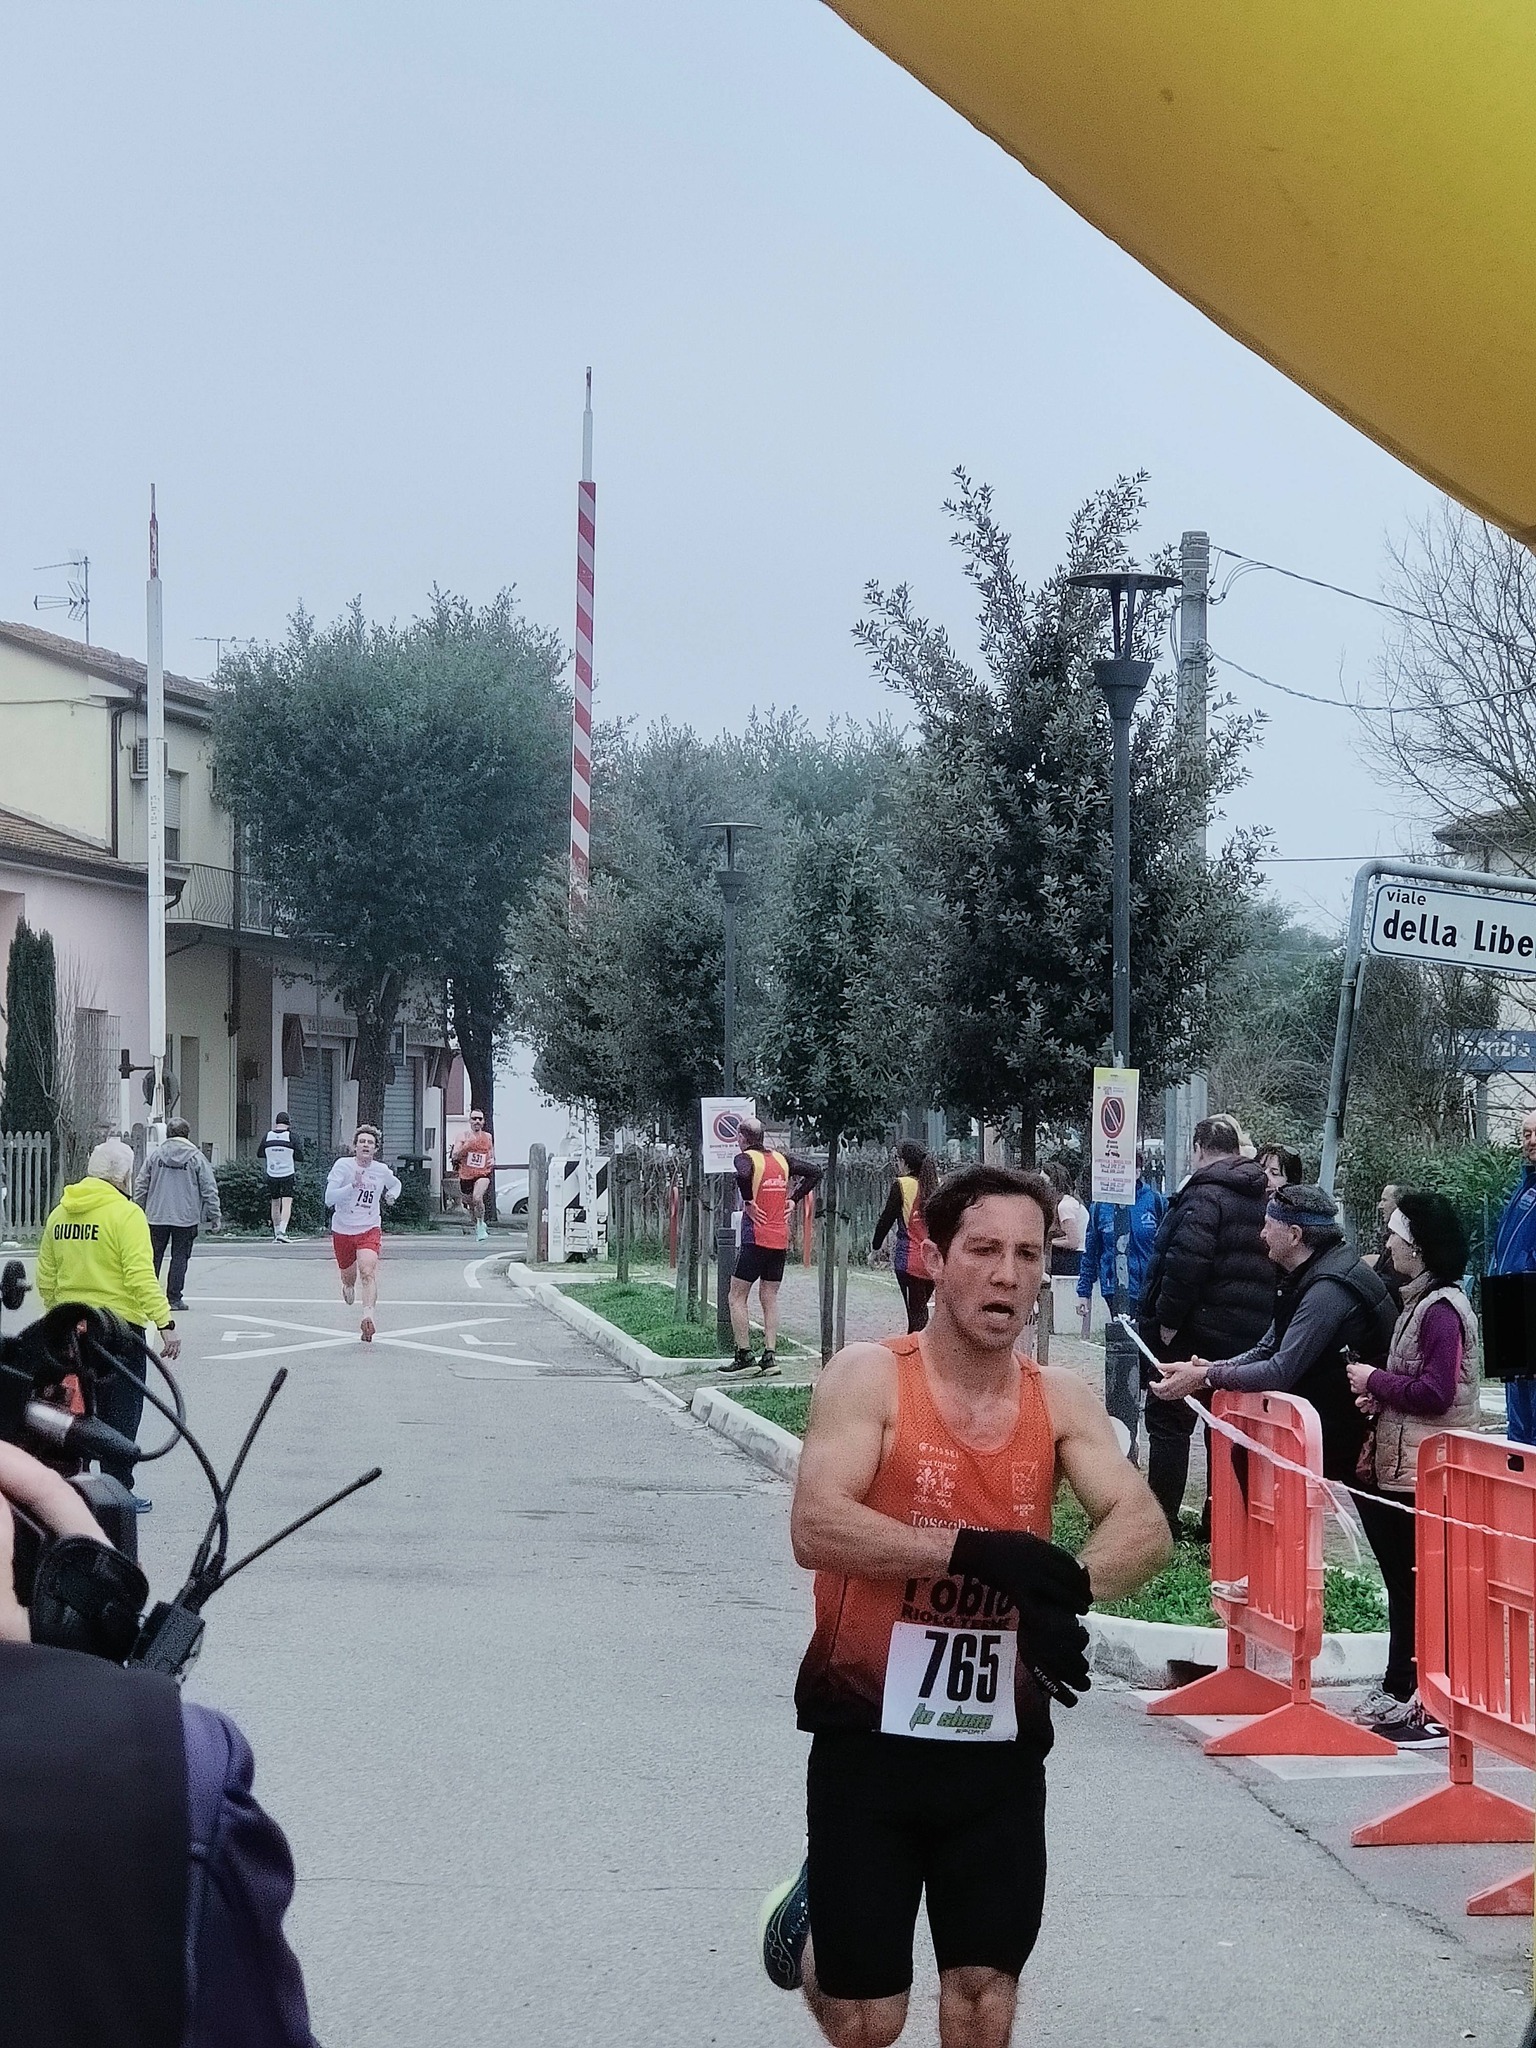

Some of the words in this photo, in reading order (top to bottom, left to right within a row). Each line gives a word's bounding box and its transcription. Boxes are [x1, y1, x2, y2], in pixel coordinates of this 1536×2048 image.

[1386, 889, 1427, 906] viale
[1383, 909, 1458, 948] della
[1473, 919, 1536, 958] Libe
[357, 1188, 374, 1204] 795
[54, 1223, 99, 1241] GIUDICE
[918, 1630, 1002, 1703] 765
